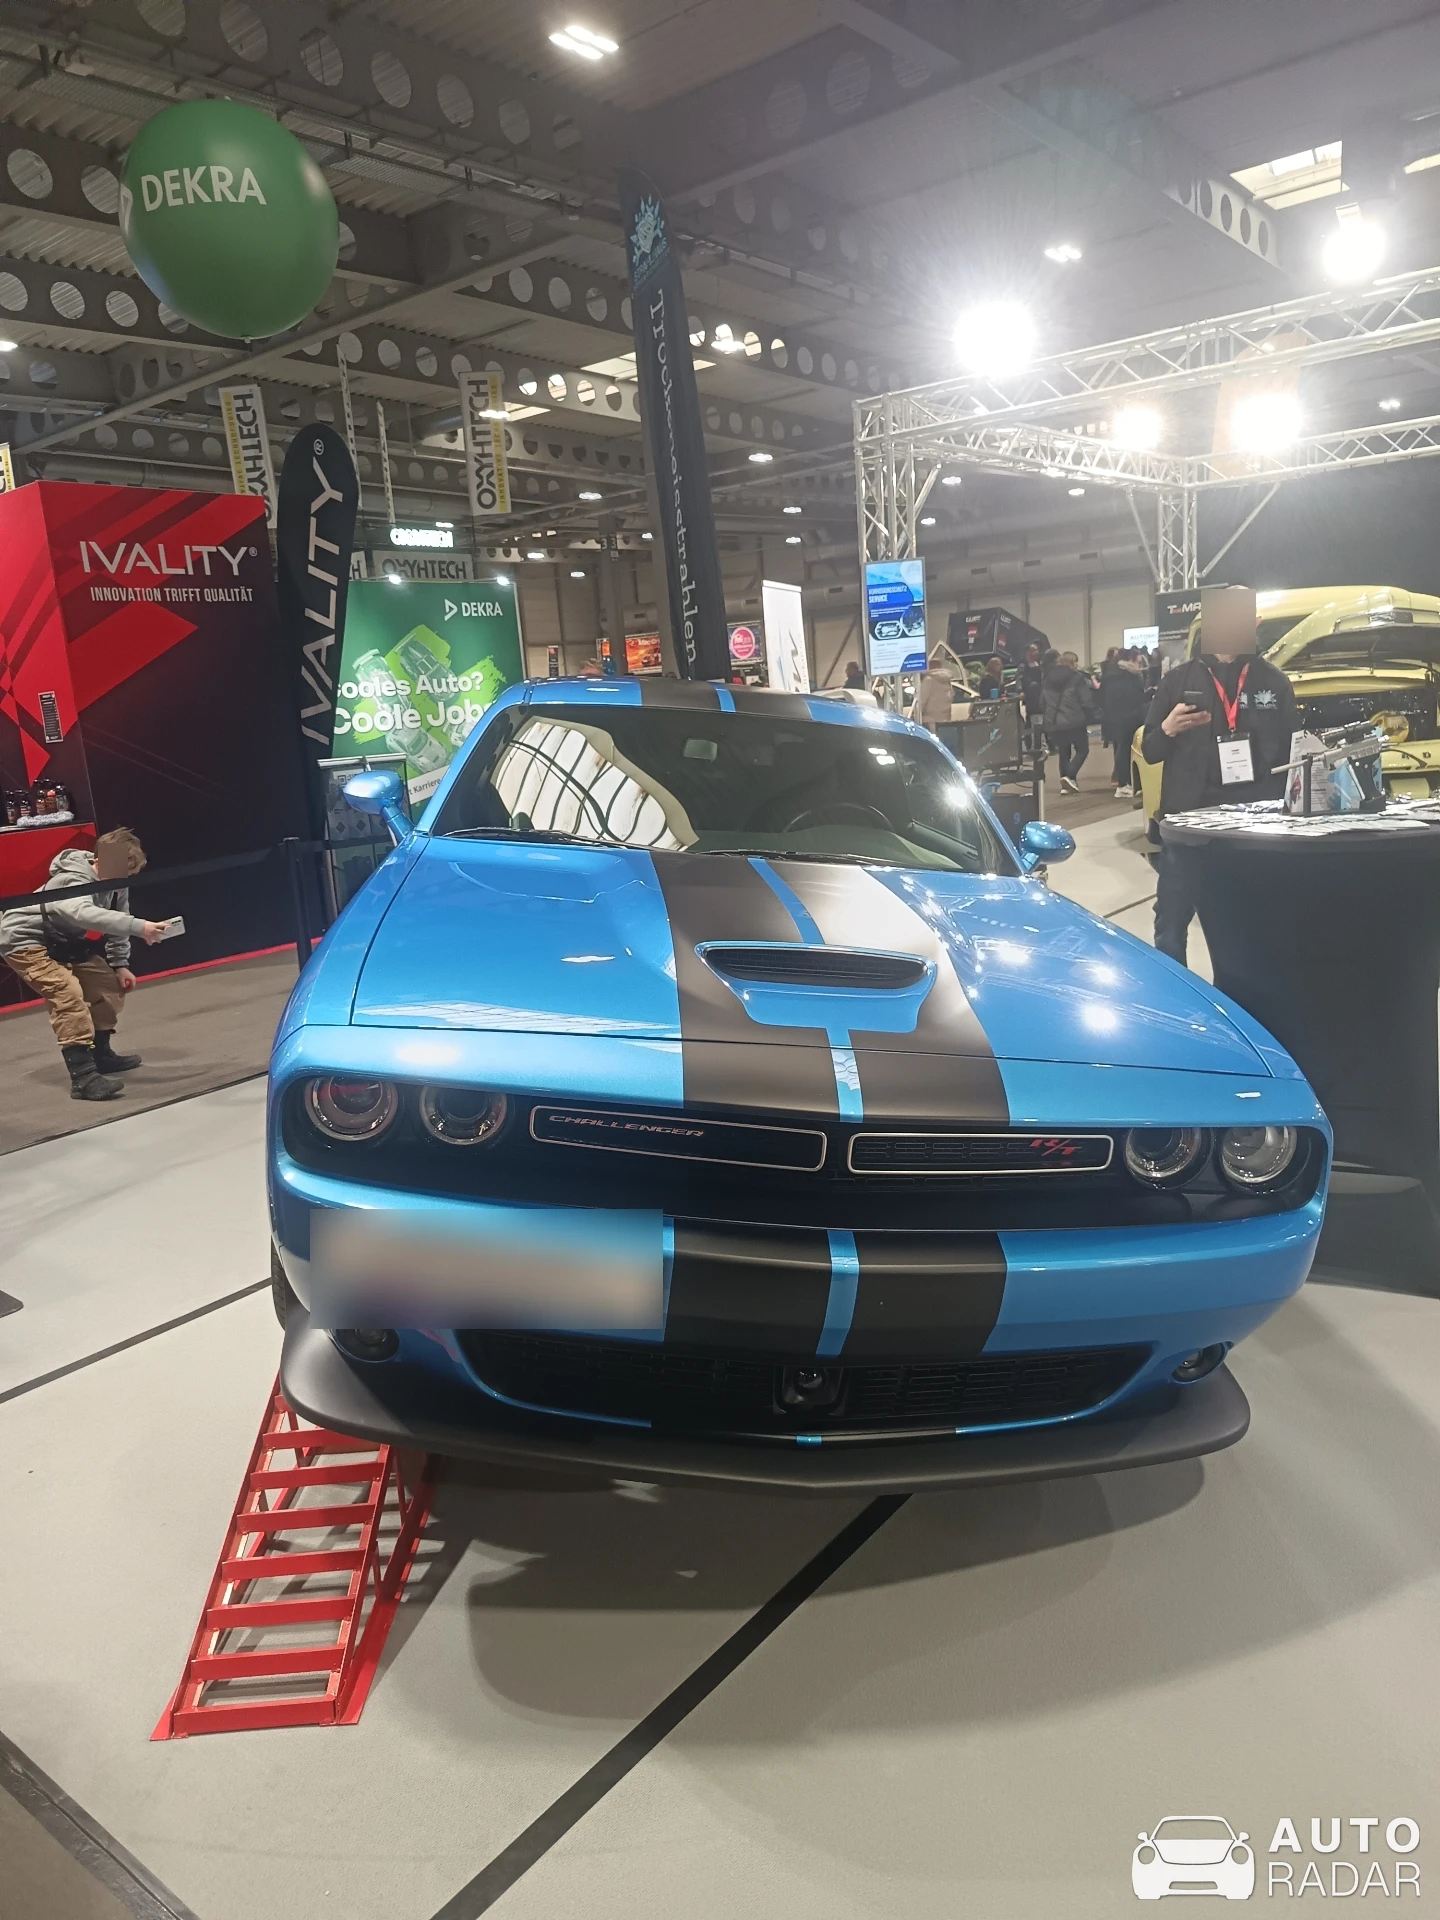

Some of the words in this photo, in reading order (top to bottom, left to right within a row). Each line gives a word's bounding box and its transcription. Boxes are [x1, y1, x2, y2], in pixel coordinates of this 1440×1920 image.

[141, 165, 267, 212] DEKRA
[381, 558, 467, 580] OXYHTECH
[90, 587, 162, 602] INNOVATION
[163, 587, 201, 602] TRIFFT
[203, 586, 253, 603] QUALITÄT
[461, 601, 503, 617] DEKRA
[415, 671, 484, 695] Auto?
[333, 703, 422, 735] Coole
[549, 1115, 704, 1137] CHALLENGER
[1028, 1138, 1083, 1157] R/T
